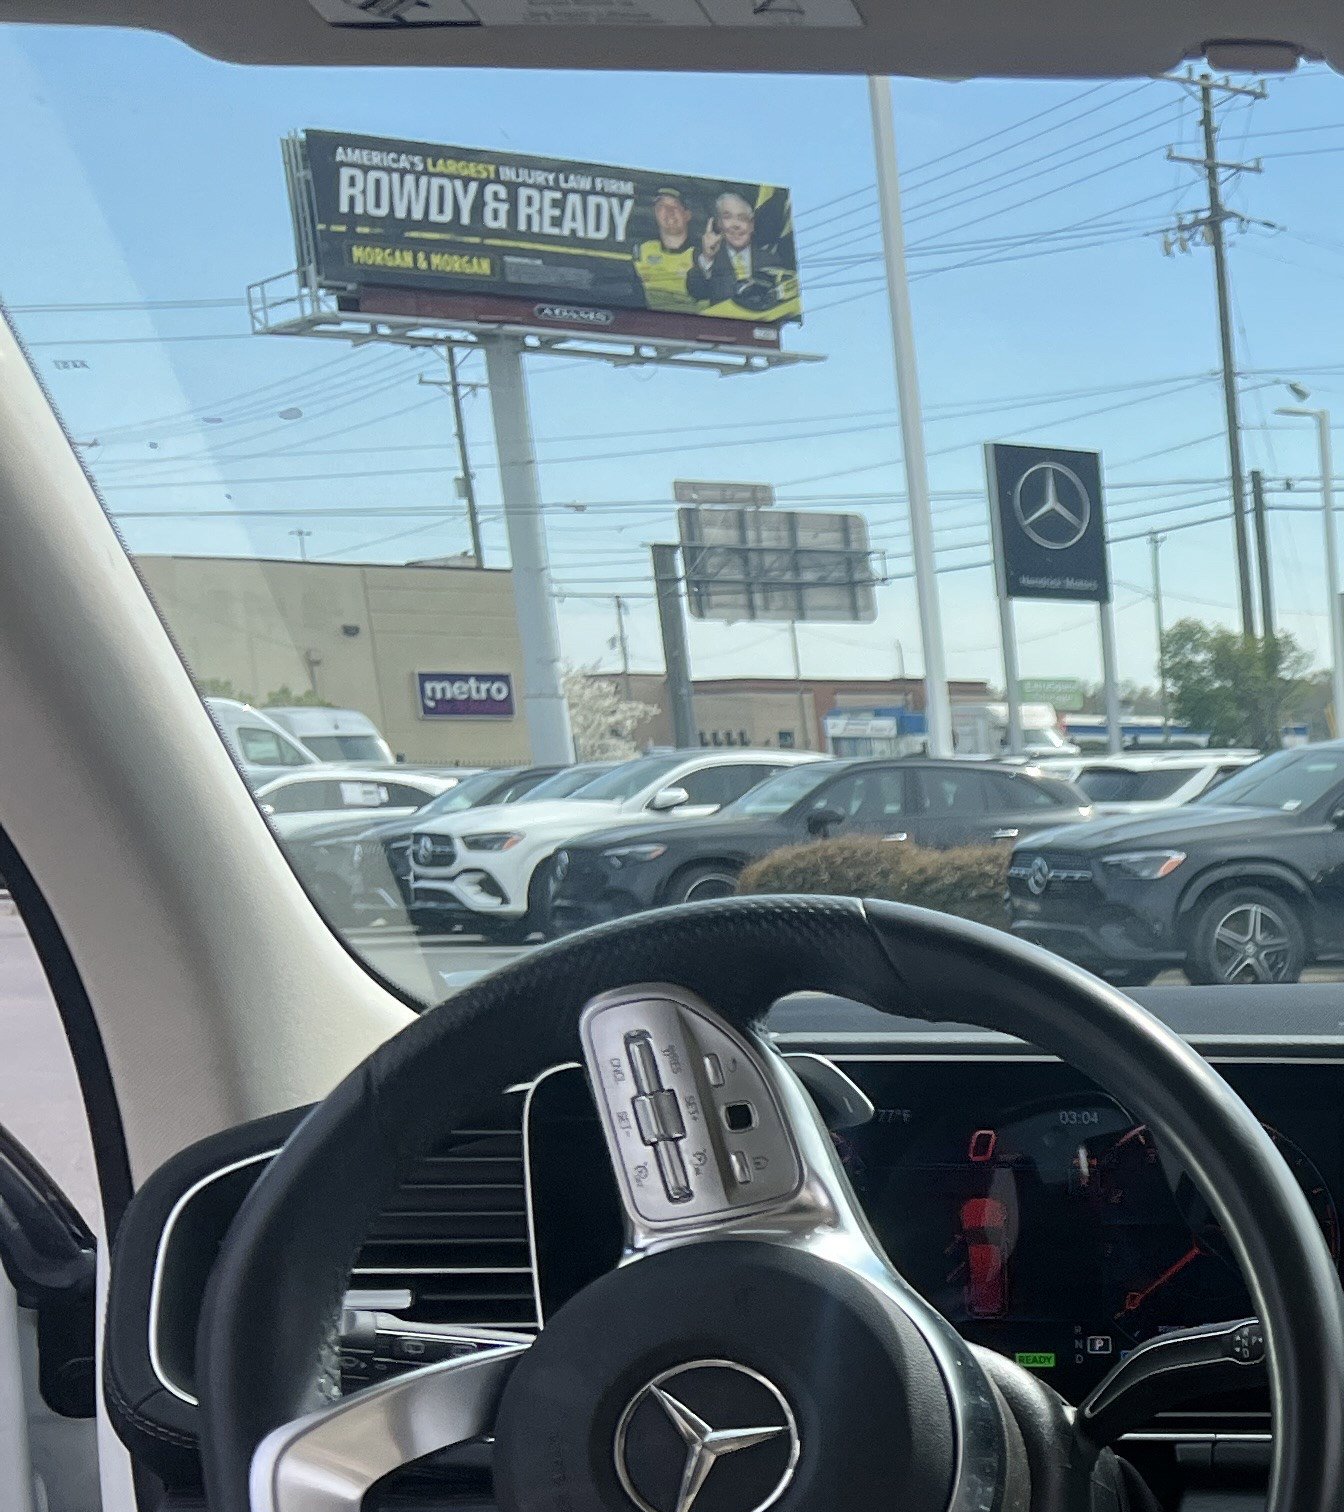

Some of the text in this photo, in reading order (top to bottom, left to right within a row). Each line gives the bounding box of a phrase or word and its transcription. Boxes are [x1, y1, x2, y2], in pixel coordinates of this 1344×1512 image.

[335, 146, 635, 195] AMERICA'S LARGEST INJURY LAW FIRM
[338, 166, 636, 242] ROWDY & READY
[352, 244, 415, 268] MORGAN
[416, 250, 428, 270] &
[430, 252, 492, 276] MORGAN
[423, 676, 509, 708] metro
[1059, 1111, 1099, 1125] 03:04
[968, 1129, 997, 1162] 0
[1018, 1354, 1054, 1365] READY
